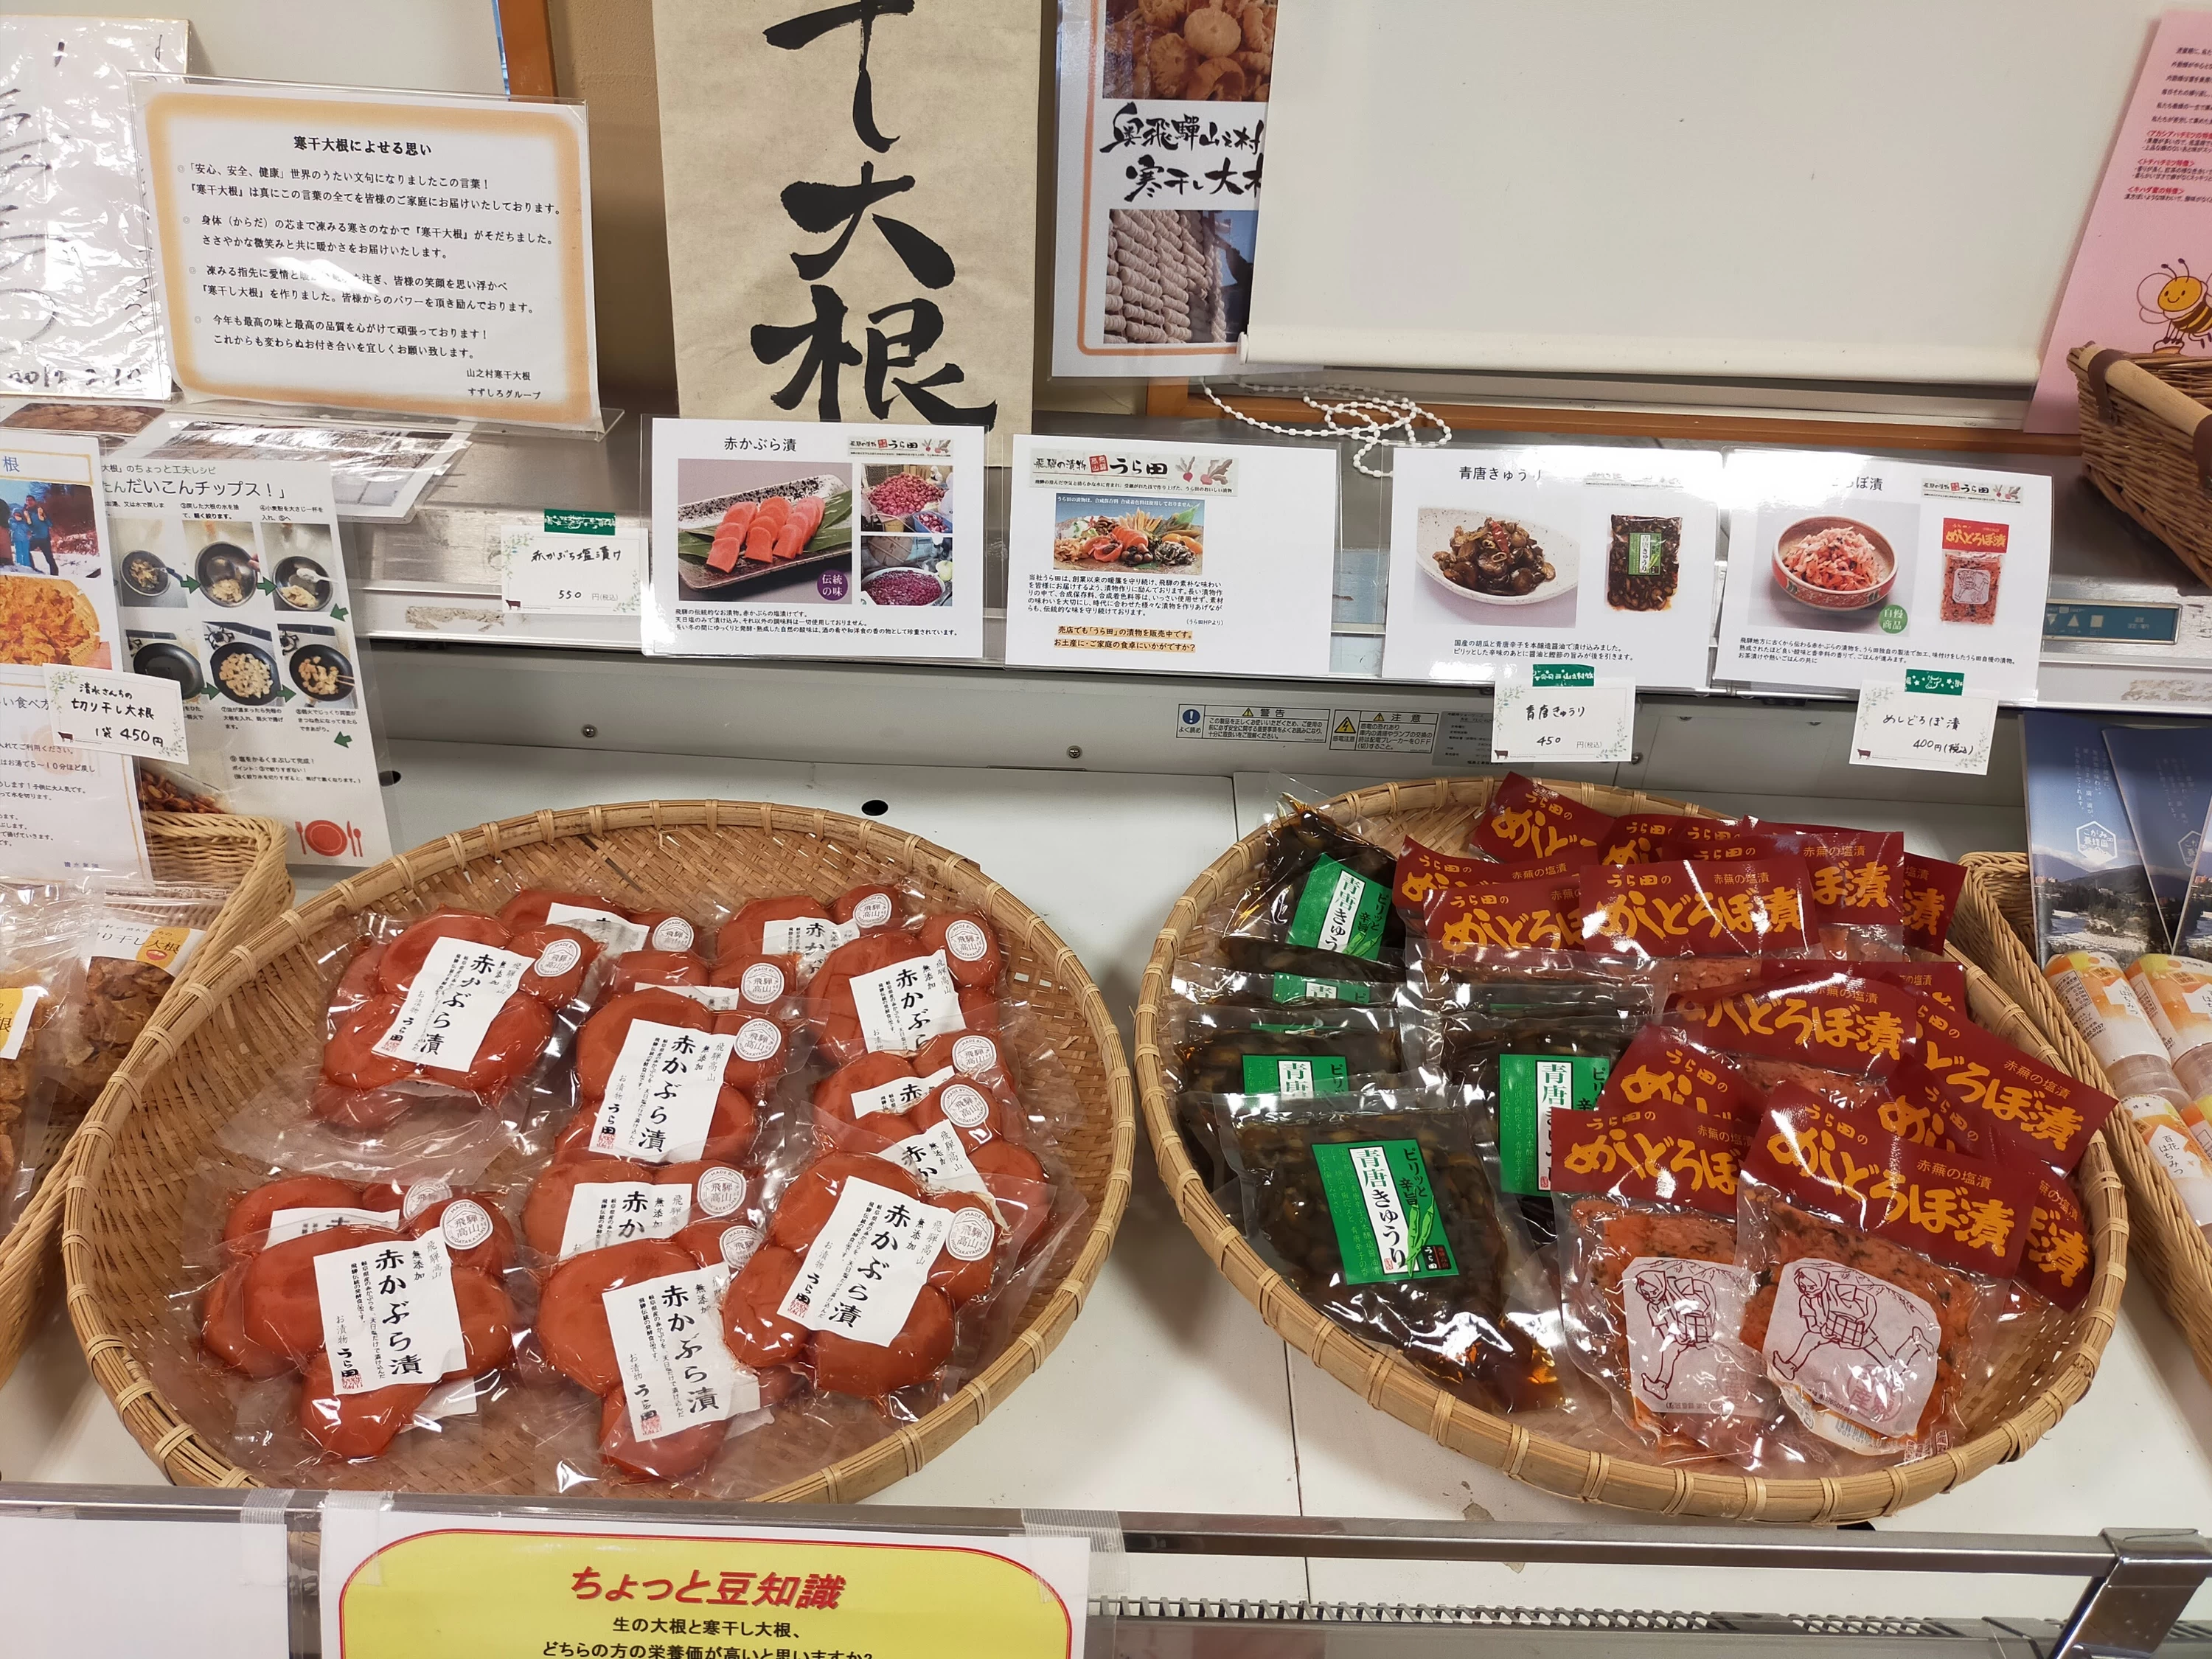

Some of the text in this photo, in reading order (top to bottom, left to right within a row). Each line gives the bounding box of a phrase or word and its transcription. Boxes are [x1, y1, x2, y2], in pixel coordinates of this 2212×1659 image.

[293, 136, 432, 156] 寒干大根によせる思い
[467, 369, 531, 381] 山之村寒干大根
[467, 388, 541, 400] すずしろグループ
[723, 437, 797, 453] 赤かぶら漬
[1110, 458, 1168, 475] うら田
[821, 574, 843, 585] 伝統
[558, 589, 582, 600] 550
[821, 585, 844, 597] の味
[1882, 619, 1902, 630] 商品
[71, 698, 155, 720] 切り干し大根
[1260, 708, 1285, 717] 警告
[1391, 713, 1422, 723] 注意
[1526, 704, 1585, 720] 青唐きゅうり
[1882, 714, 1961, 731] めしどろぼ漬
[1537, 736, 1562, 746] 450
[1419, 855, 1472, 874] うら田の
[1512, 862, 1568, 880] 赤蕪の塩漬
[1607, 873, 1672, 888] うら田の
[420, 954, 495, 1056] 赤かぶら漬
[390, 1018, 414, 1041] うら田
[1666, 1049, 1728, 1093] うら田の
[2003, 1059, 2070, 1099] 赤蕪の塩漬
[639, 1035, 696, 1153] 赤かぶら漬
[602, 1103, 620, 1135] うら田
[2163, 1135, 2180, 1151] 百花
[2158, 1144, 2184, 1175] はちみつ
[1404, 1148, 1427, 1197] ピリッと
[1916, 1158, 1993, 1191] 赤蕪の塩漬
[1399, 1178, 1417, 1206] 辛旨
[1767, 1127, 2014, 1257] めしどろぼ漬
[1357, 1149, 1407, 1269] 青唐きゅうり
[456, 1225, 480, 1237] 高山
[905, 1218, 925, 1251] 無添加
[957, 1236, 978, 1248] 高山
[961, 1224, 983, 1238] 飛騨
[411, 1250, 425, 1281] 無添加
[829, 1204, 911, 1328] 赤かぶら漬
[1425, 1247, 1437, 1269] うら田
[795, 1273, 820, 1304] うら田
[375, 1249, 422, 1375] 赤かぶら漬
[661, 1285, 719, 1413] 赤かぶら漬
[337, 1348, 358, 1377] うら田
[571, 1565, 847, 1610] ちょっと豆知識
[613, 1616, 800, 1639] 生の大根と寒干し大根、
